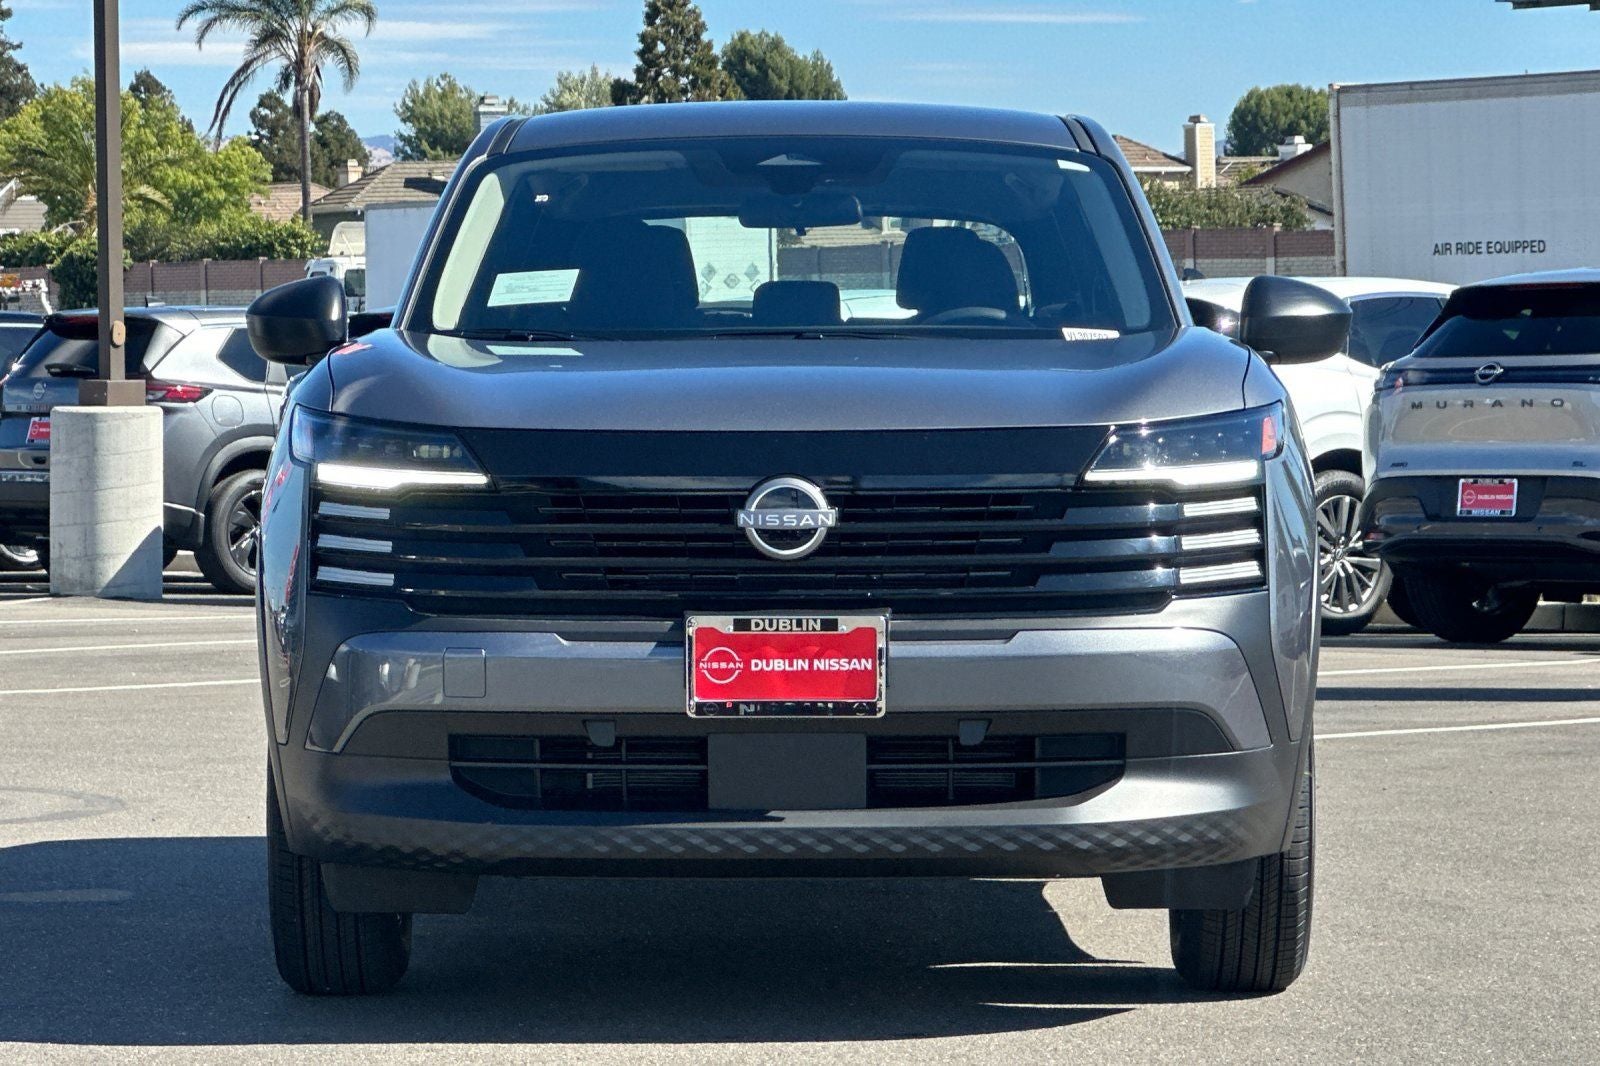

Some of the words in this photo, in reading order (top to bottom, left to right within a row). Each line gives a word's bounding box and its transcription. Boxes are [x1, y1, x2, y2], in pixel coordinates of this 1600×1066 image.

[1433, 242, 1452, 256] AIR
[1455, 241, 1483, 255] RIDE
[1486, 240, 1546, 254] EQUIPPED
[1410, 398, 1565, 410] MURANO
[740, 513, 833, 527] NISSAN
[750, 618, 821, 632] DUBLIN
[699, 661, 744, 669] NISSAN
[750, 658, 809, 671] DUBLIN
[813, 658, 872, 671] NISSAN
